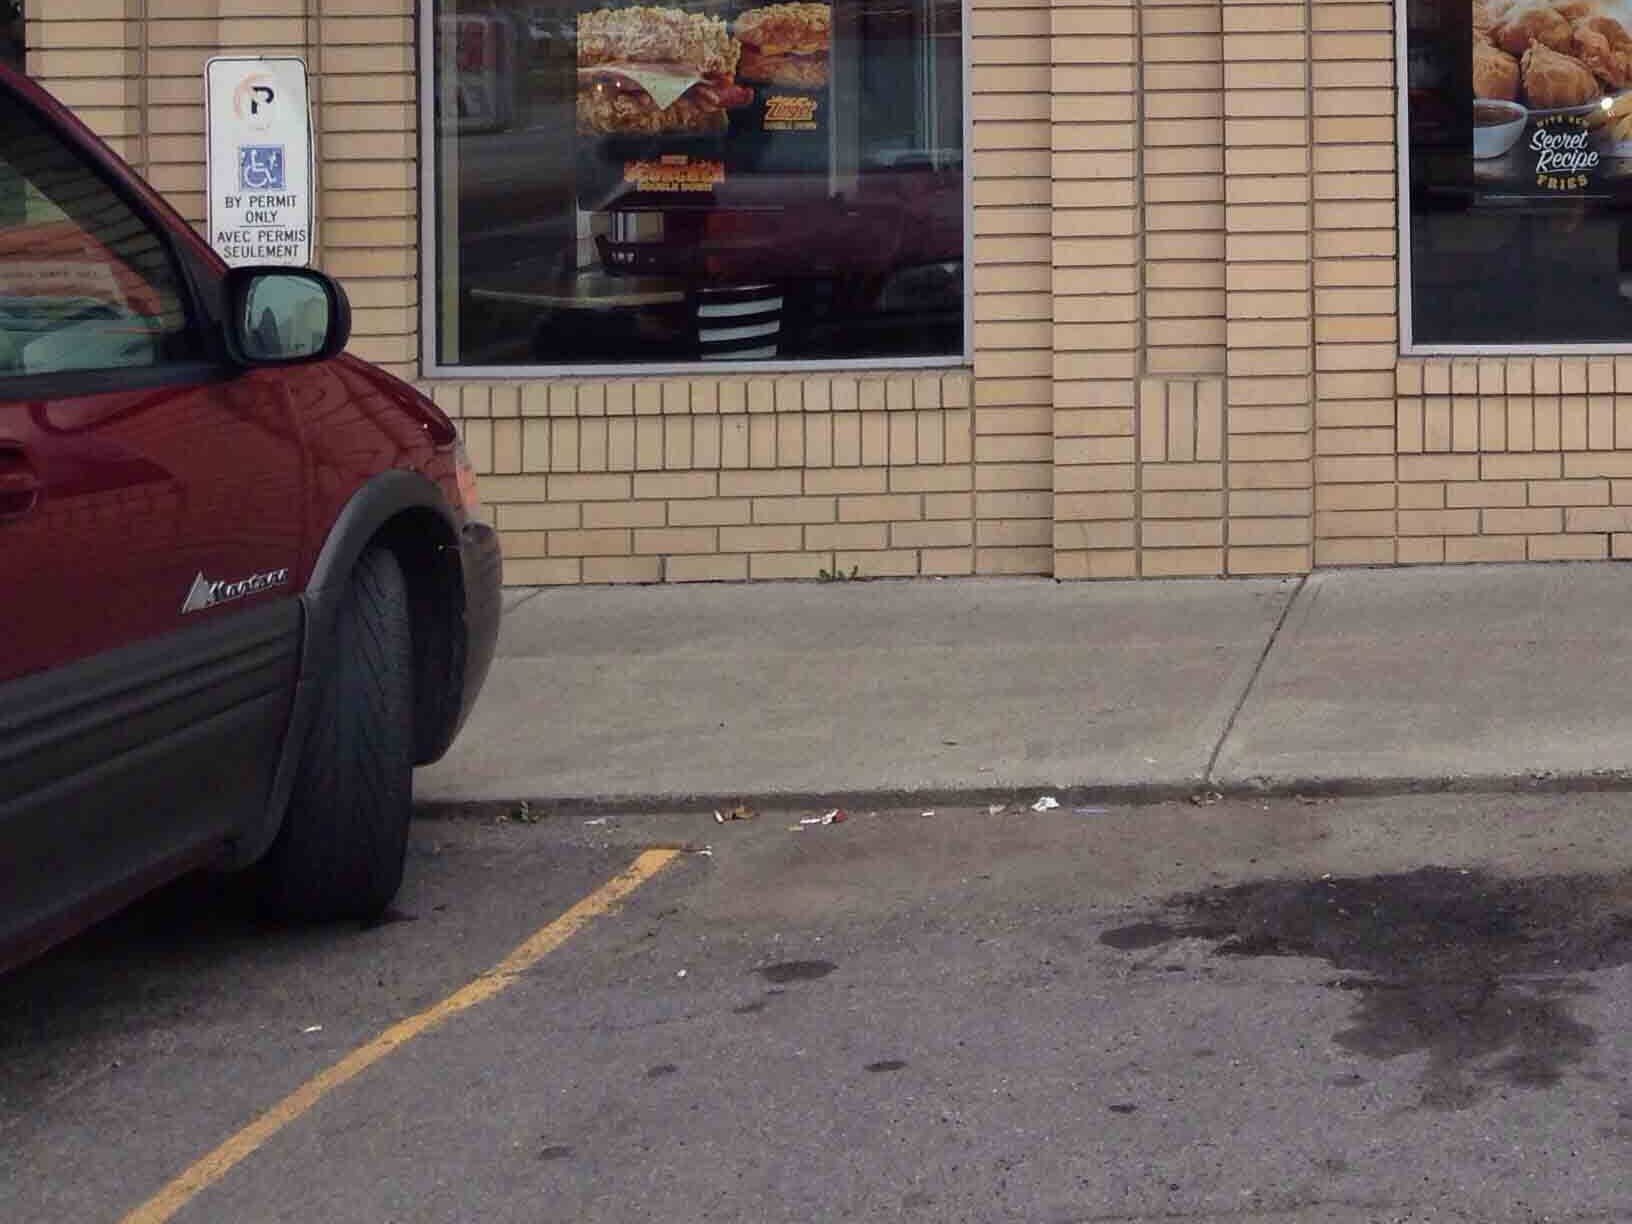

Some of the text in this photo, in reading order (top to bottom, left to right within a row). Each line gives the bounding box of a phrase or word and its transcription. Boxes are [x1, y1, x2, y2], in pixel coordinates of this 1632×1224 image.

[1529, 128, 1589, 151] Secret
[1535, 148, 1600, 174] Recipe
[1536, 174, 1589, 190] FRIES
[224, 195, 297, 209] BY PERMIT
[245, 211, 279, 224] ONLY
[217, 229, 306, 243] AVEC PERMIS
[222, 244, 300, 259] SEULEMENT
